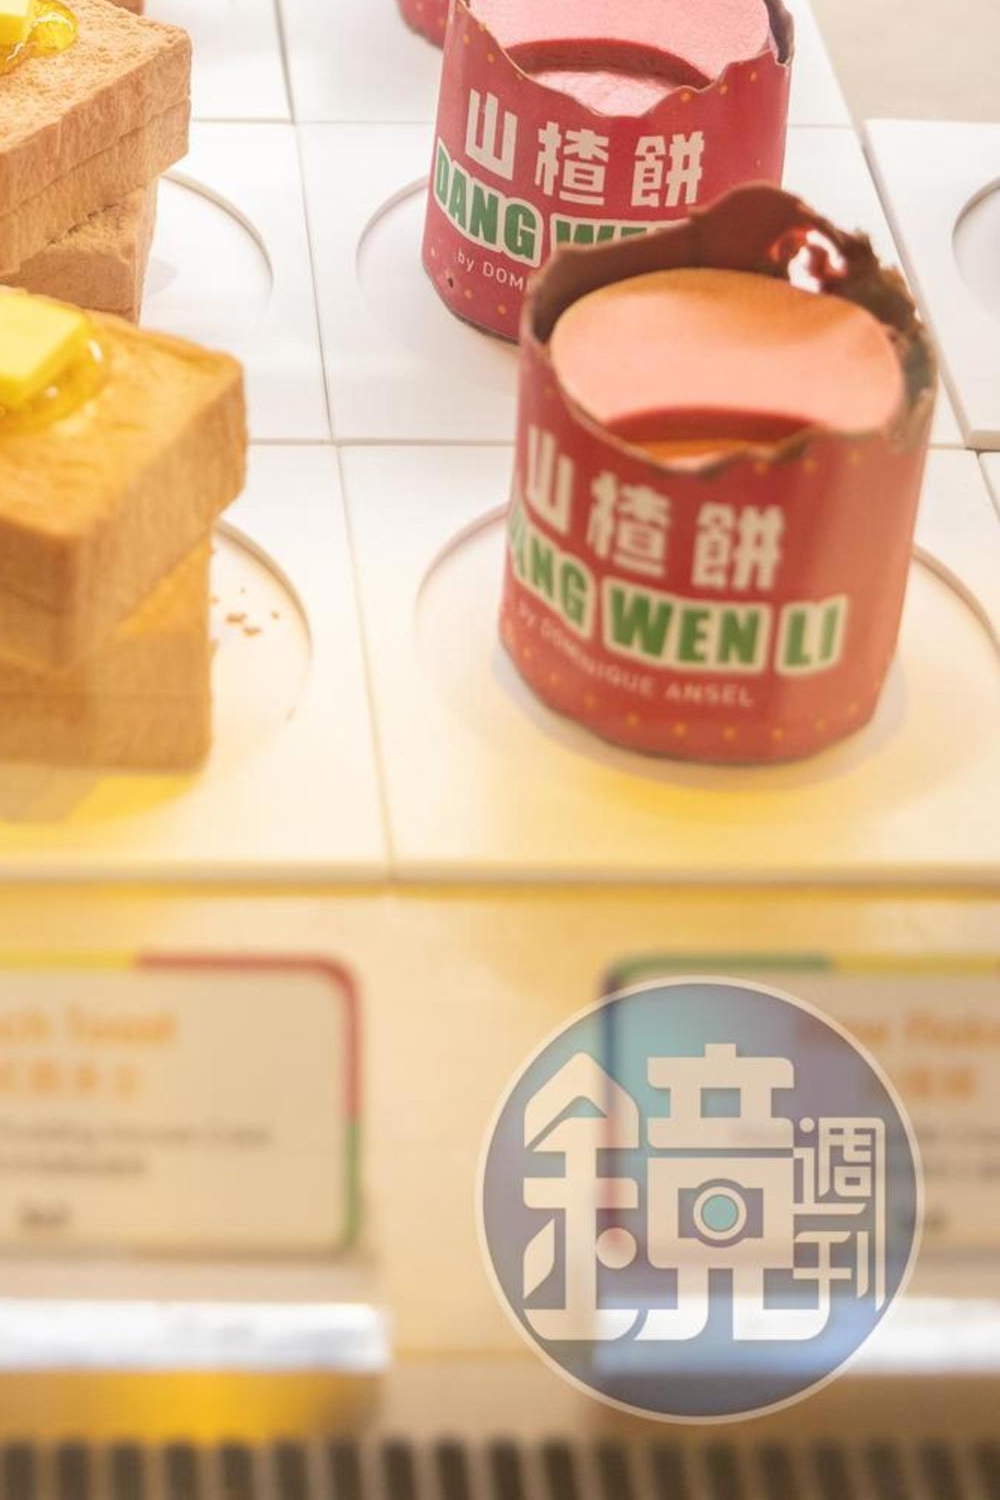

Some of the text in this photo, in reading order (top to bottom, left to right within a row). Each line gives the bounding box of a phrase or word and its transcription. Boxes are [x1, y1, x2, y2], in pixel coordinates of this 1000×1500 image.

[465, 88, 705, 207] 山楂餅
[434, 145, 540, 264] DANG
[457, 247, 474, 272] by
[525, 423, 784, 592] 山楂餅
[606, 581, 765, 669] WEN
[779, 600, 844, 671] LI
[664, 680, 754, 708] ANSEL
